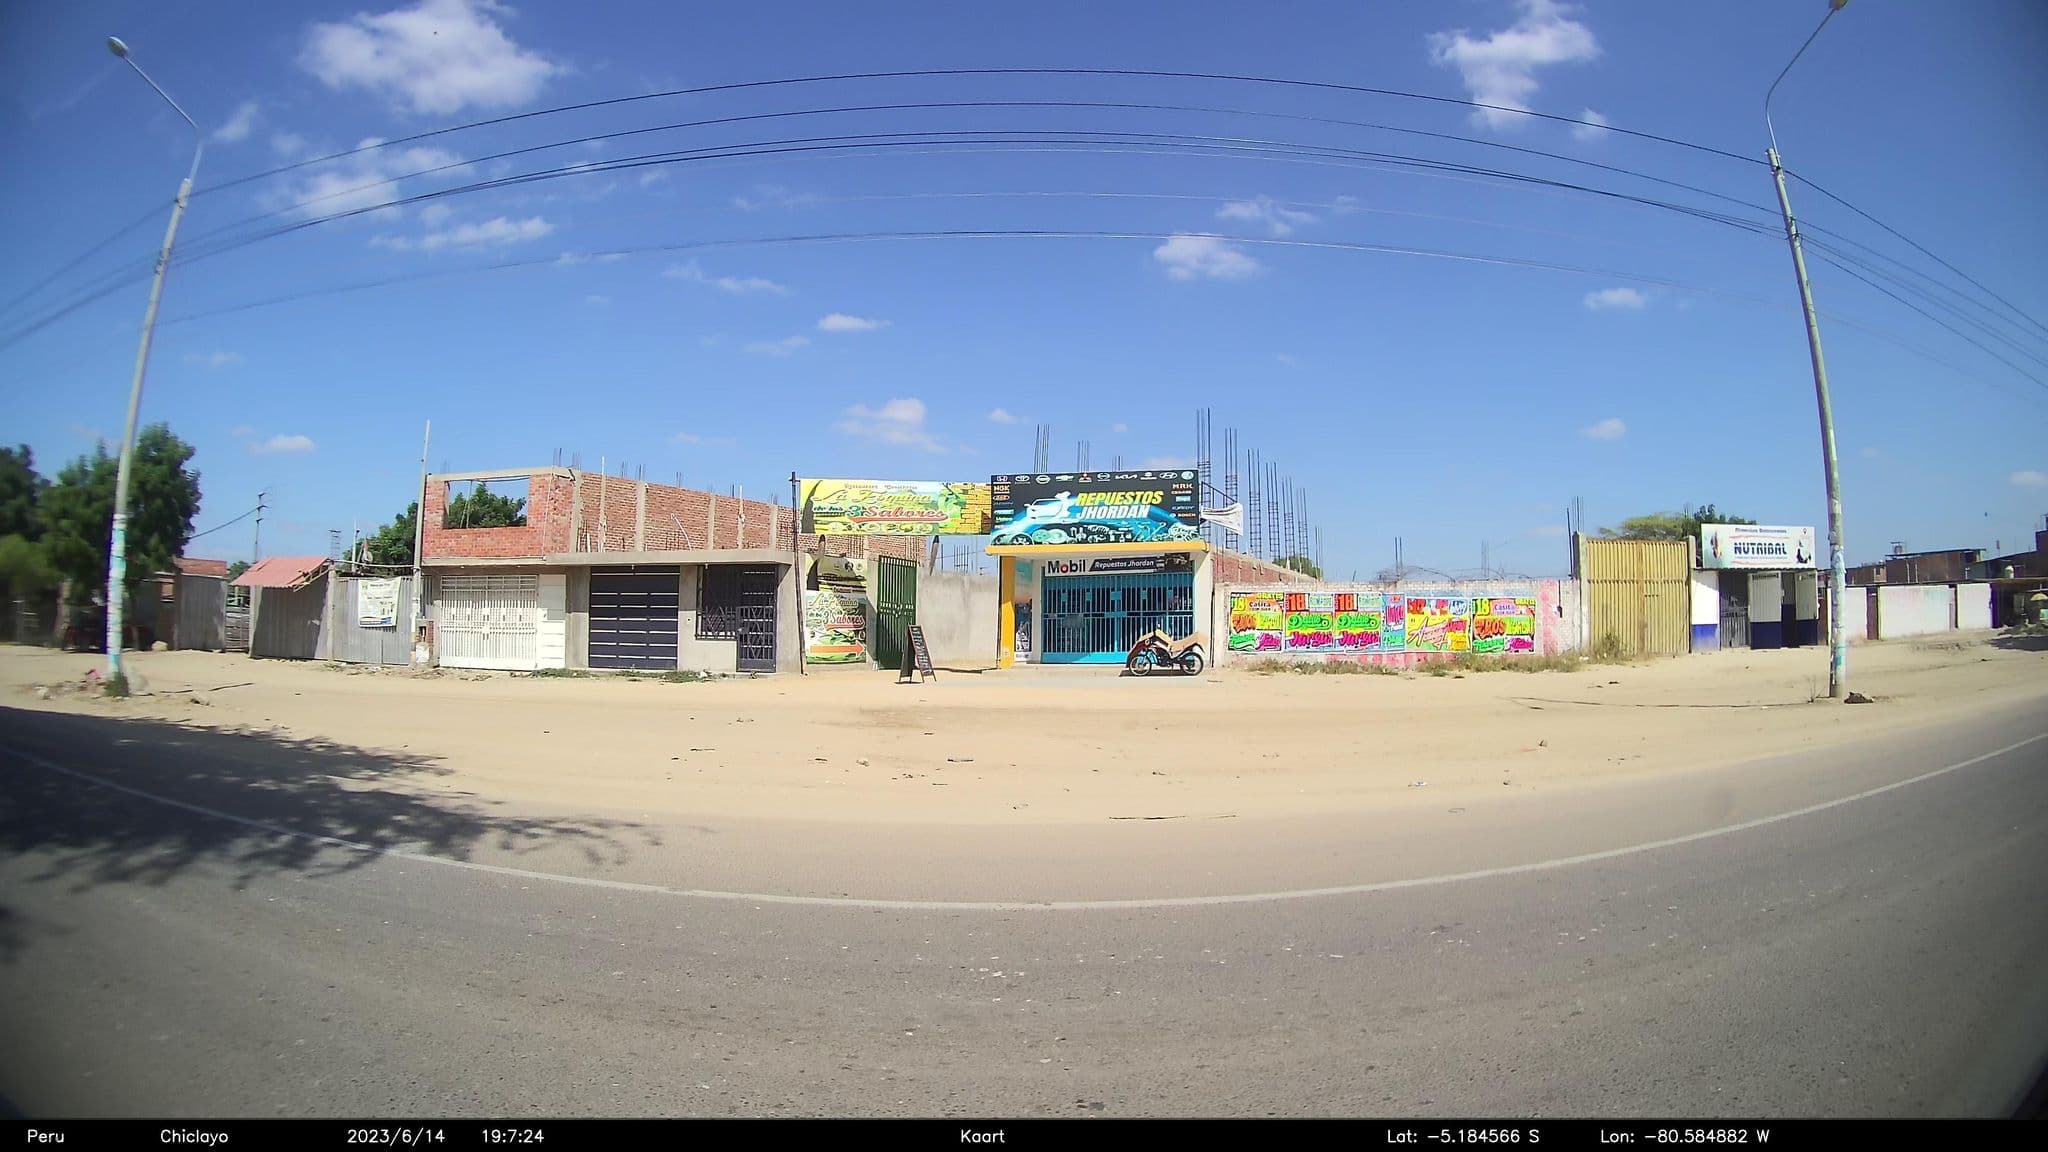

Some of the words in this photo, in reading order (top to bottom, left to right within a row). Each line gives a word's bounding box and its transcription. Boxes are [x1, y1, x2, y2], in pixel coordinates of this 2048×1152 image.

[1076, 490, 1164, 506] REPUESTOS
[865, 506, 948, 519] Sabores
[1076, 504, 1151, 519] JHORDAN
[1734, 542, 1788, 555] NUTRIBAL
[1047, 559, 1086, 574] Mobil
[1094, 560, 1127, 570] Repuestos
[1128, 559, 1154, 568] Jhordan
[1288, 593, 1305, 611] 18
[1337, 593, 1354, 611] 18
